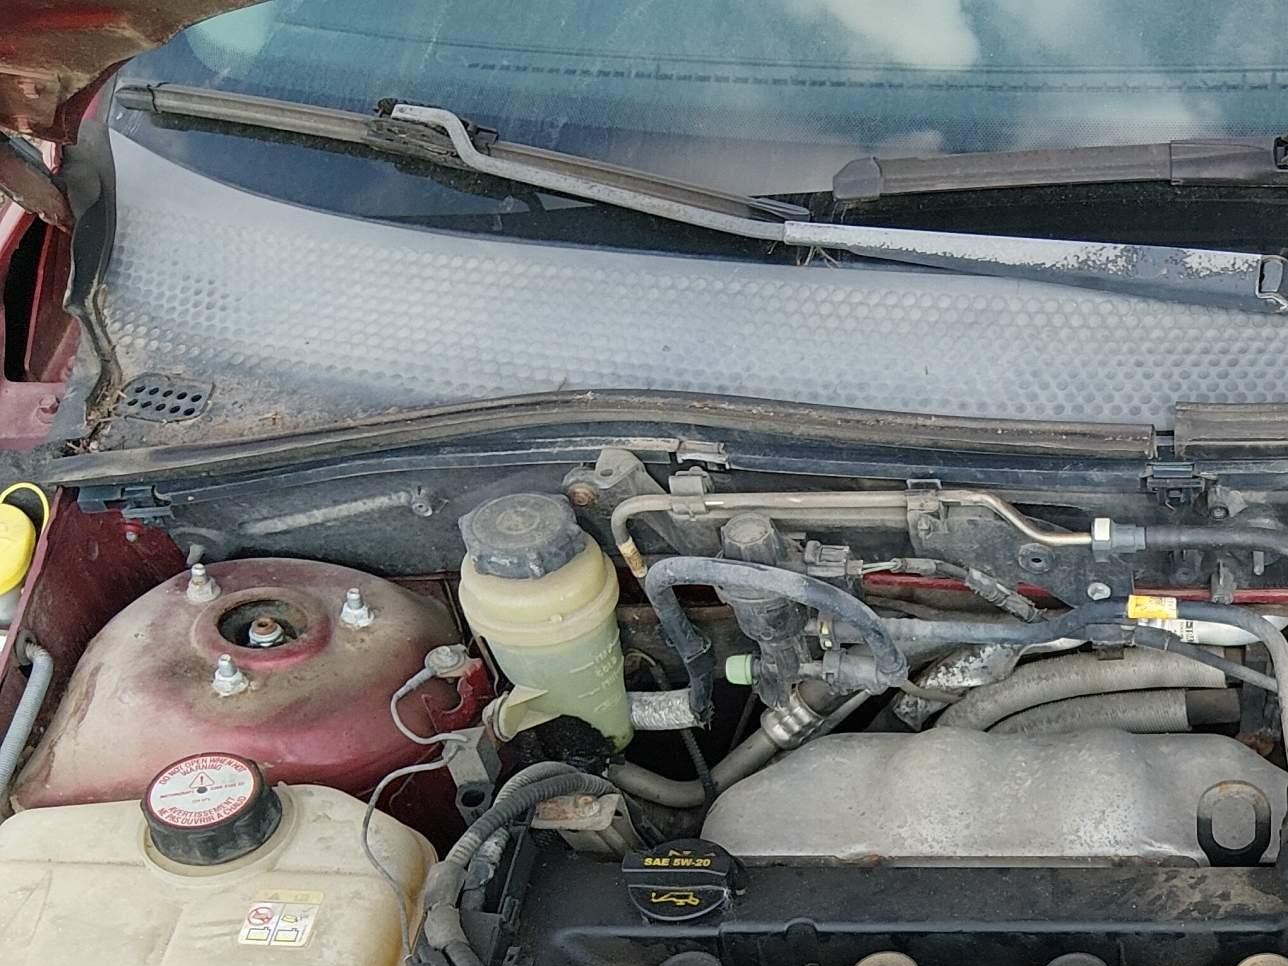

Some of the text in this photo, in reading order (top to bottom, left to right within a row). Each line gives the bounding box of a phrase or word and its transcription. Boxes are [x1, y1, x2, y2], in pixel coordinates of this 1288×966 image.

[159, 775, 170, 785] DO
[185, 758, 208, 768] OPEN
[180, 763, 223, 777] WARNING
[644, 858, 711, 867] SAE 5W-20
